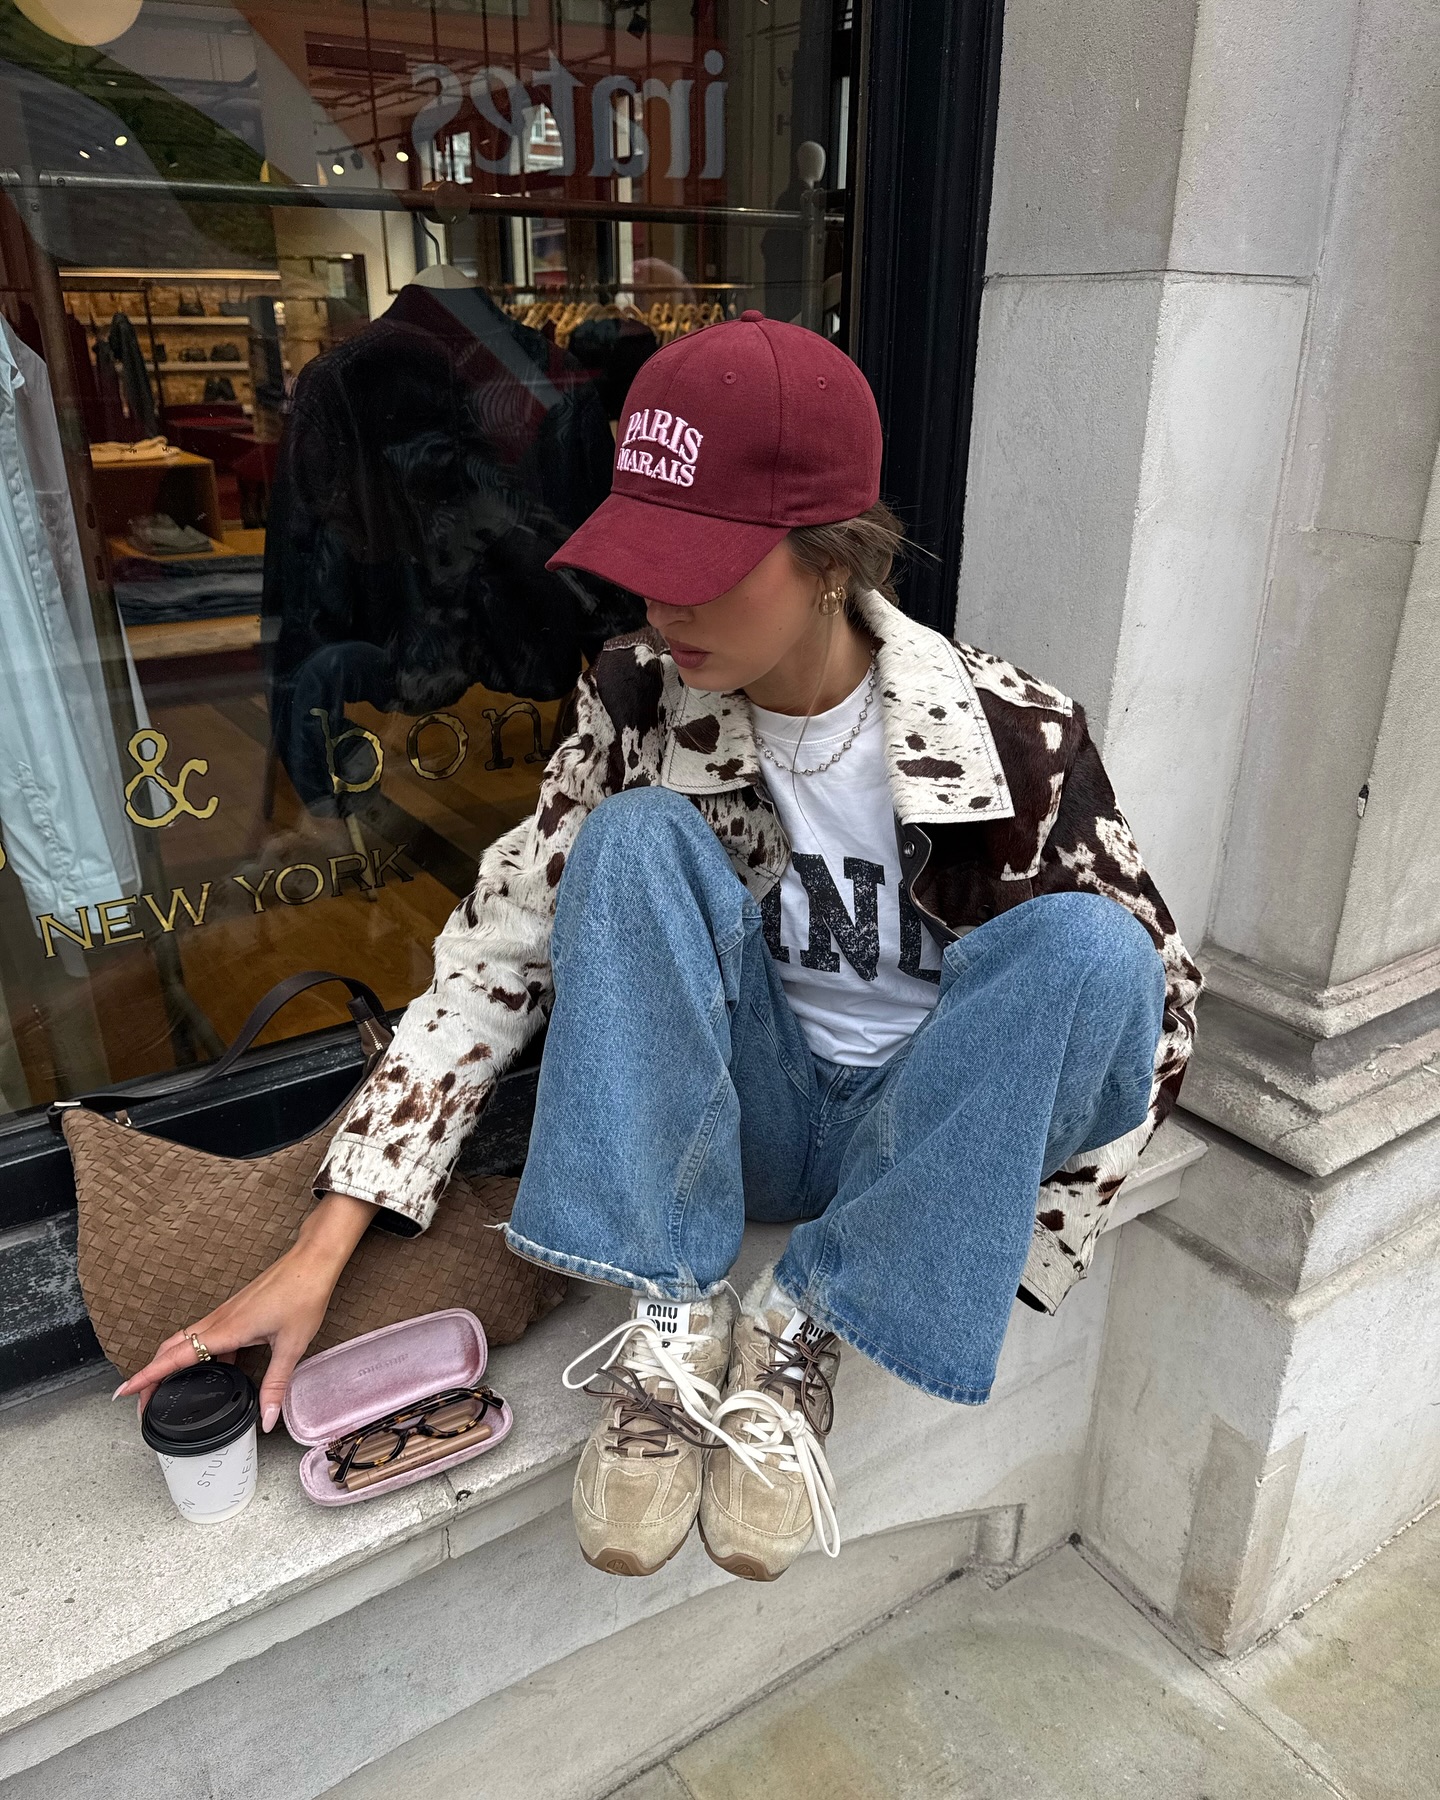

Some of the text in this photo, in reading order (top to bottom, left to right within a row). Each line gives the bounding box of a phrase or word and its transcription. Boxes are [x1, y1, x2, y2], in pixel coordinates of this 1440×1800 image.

[616, 447, 696, 487] MARAIS
[622, 408, 703, 464] PARIS
[125, 728, 219, 828] &
[36, 843, 414, 959] NEW YORK
